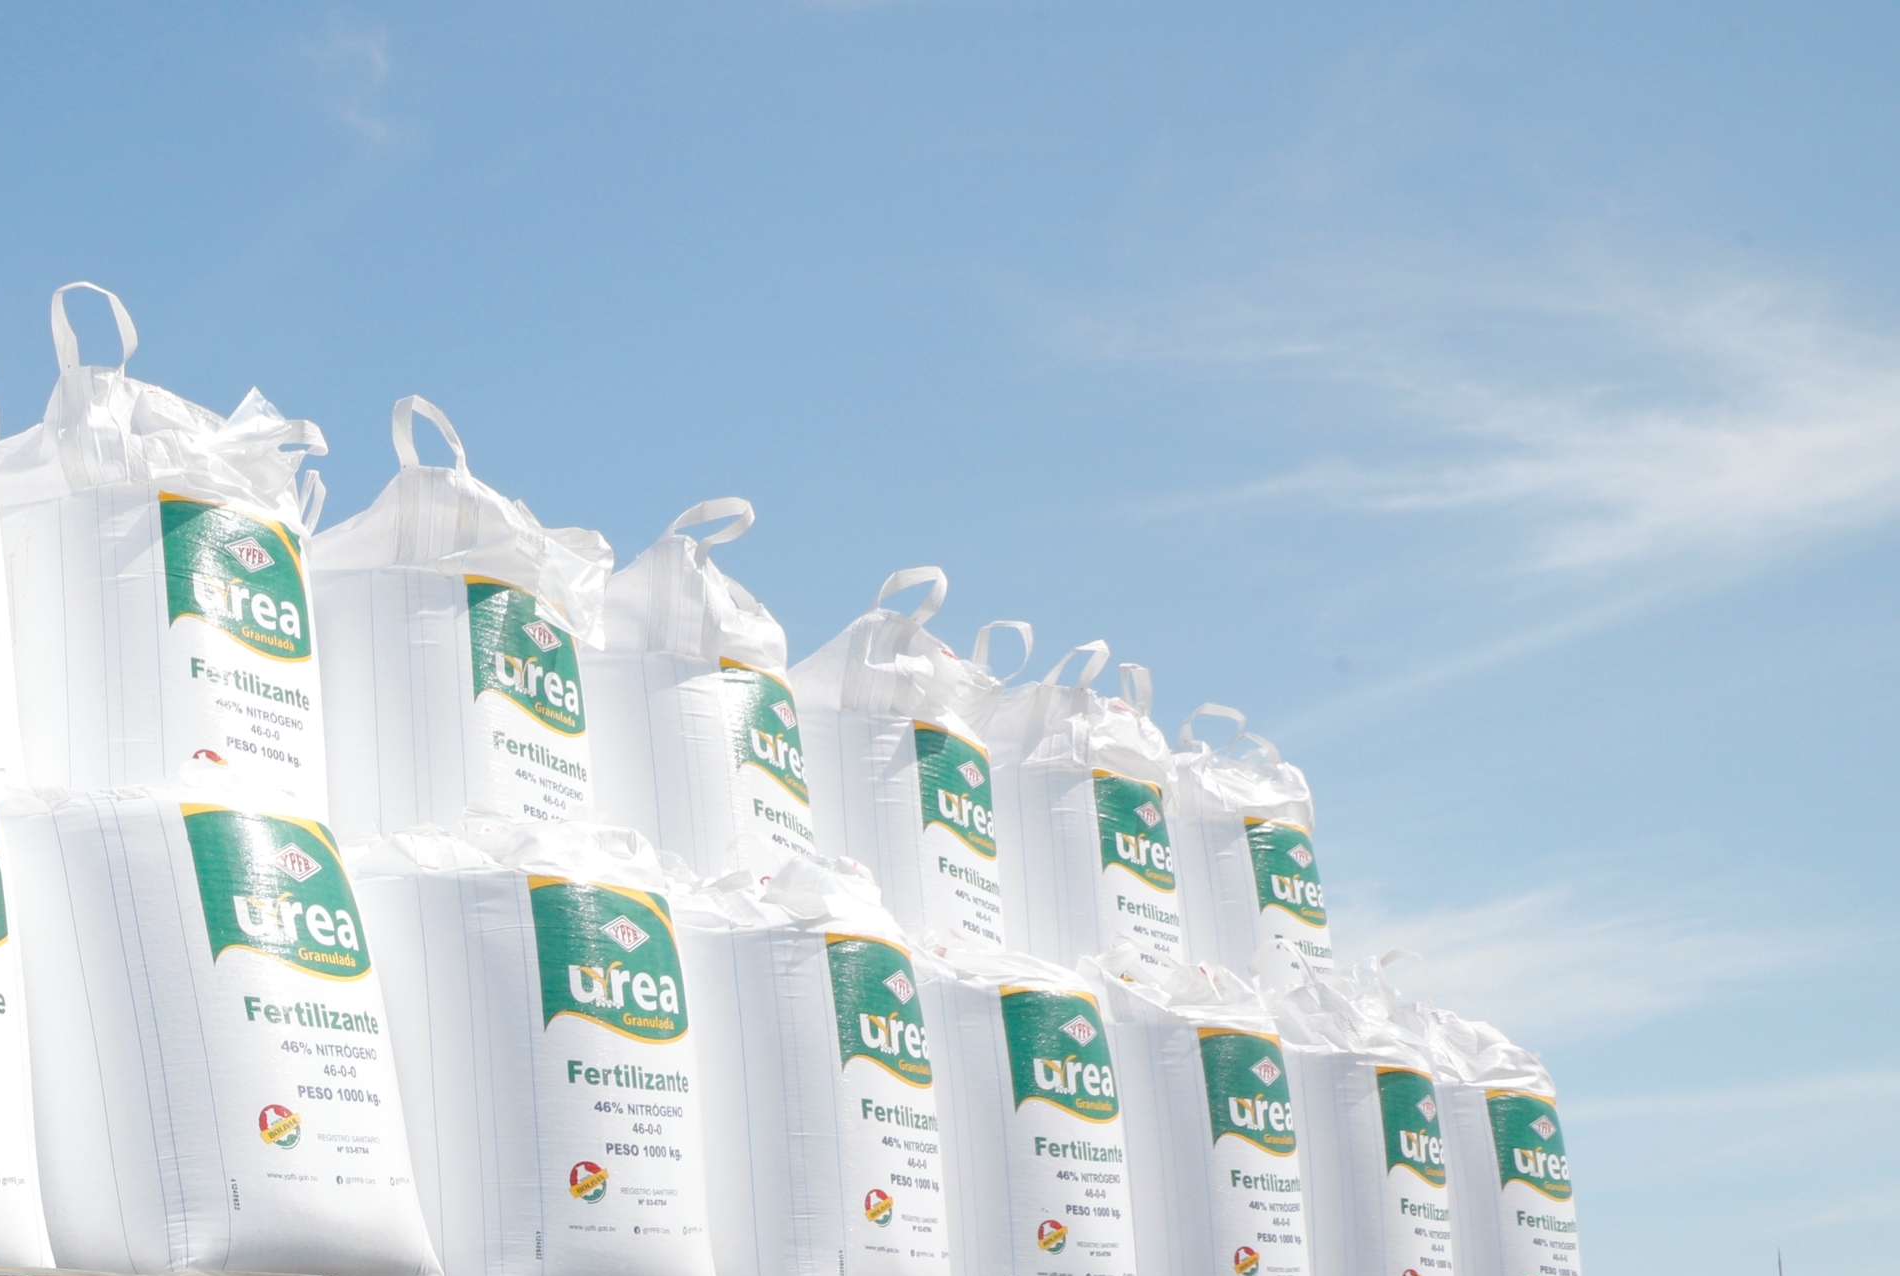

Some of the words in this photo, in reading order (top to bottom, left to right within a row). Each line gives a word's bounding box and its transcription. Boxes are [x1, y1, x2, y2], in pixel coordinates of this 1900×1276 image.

[192, 571, 301, 640] urea
[241, 625, 295, 652] Granulada
[494, 651, 580, 716] urea
[246, 705, 303, 731] NITRÓGENO
[534, 701, 576, 728] Granulada
[251, 724, 280, 741] 46-0-0
[226, 736, 257, 754] PESO
[261, 746, 285, 762] 1000
[287, 752, 302, 768] kg.
[515, 768, 537, 784] 46%
[539, 776, 584, 802] NITRÓGENO
[523, 804, 548, 821] PESO
[278, 850, 312, 873] YPFB
[232, 894, 360, 952] urea
[962, 919, 981, 934] PESO
[609, 923, 641, 945] YPFB
[298, 947, 357, 968] Granulada
[568, 964, 679, 1015] urea
[243, 996, 379, 1035] Fertilizante
[622, 1013, 674, 1030] Granulada
[281, 1040, 313, 1055] 46%
[316, 1043, 378, 1061] NITRÓGENO
[323, 1063, 357, 1079] 46-0-0
[567, 1059, 689, 1094] Fertilizante
[1033, 1054, 1115, 1098] urea
[297, 1085, 334, 1101] PESO
[337, 1088, 364, 1103] 1000
[366, 1090, 381, 1107] kg.
[594, 1101, 624, 1115] 46%
[627, 1102, 683, 1118] NITRÓGENO
[1228, 1094, 1295, 1132] urea
[267, 1117, 299, 1140] BOLIVIA
[317, 1133, 350, 1143] REGISTRO
[632, 1122, 662, 1136] 46-0-0
[606, 1143, 640, 1156] PESO
[643, 1144, 667, 1158] 1000
[669, 1146, 683, 1161] kg.
[881, 1136, 902, 1149] 46%
[1034, 1136, 1123, 1164] Fertilizante
[906, 1157, 928, 1170] 46-0-0
[1513, 1147, 1569, 1181] urea
[576, 1173, 606, 1194] BOLIVIA
[890, 1173, 912, 1187] PESO
[914, 1175, 931, 1190] 1000
[1056, 1170, 1079, 1182] 46%
[1080, 1171, 1121, 1184] NITRÓGENO
[1084, 1188, 1106, 1199] 46-0-0
[1065, 1204, 1090, 1217] PESO
[1092, 1206, 1110, 1217] 1000
[1249, 1201, 1268, 1212] 46%
[1257, 1232, 1278, 1244] PESO
[1540, 1265, 1557, 1276] PESO
